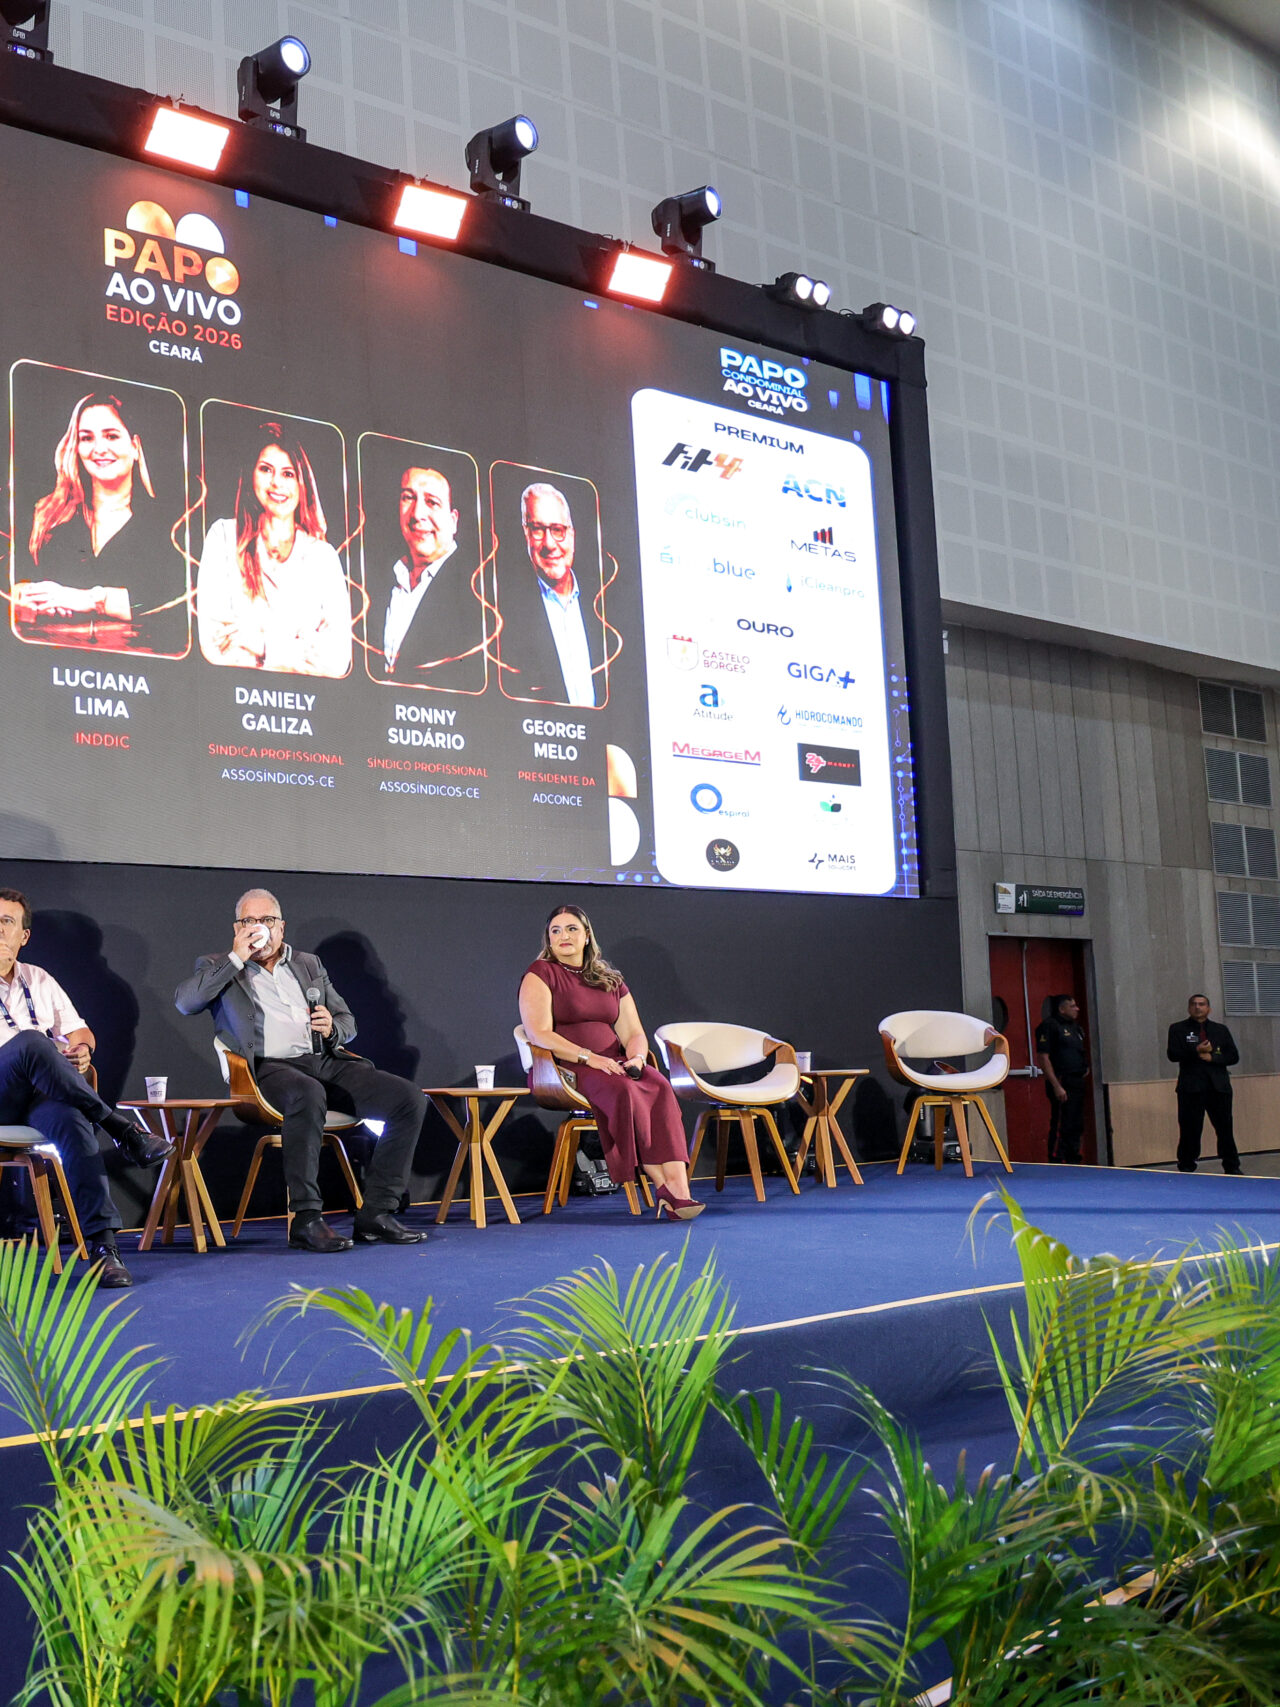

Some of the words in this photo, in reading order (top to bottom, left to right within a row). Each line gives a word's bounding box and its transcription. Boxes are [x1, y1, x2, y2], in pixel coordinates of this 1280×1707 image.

[104, 227, 240, 296] PAPO
[105, 271, 156, 306] AO
[162, 284, 242, 326] VIVO
[105, 303, 188, 337] EDIÇÃO
[193, 324, 243, 351] 2026
[148, 339, 203, 364] CEARÁ
[720, 347, 807, 389] PAPO
[721, 368, 806, 399] CONDOMINIAL
[722, 378, 754, 398] AO
[755, 386, 809, 413] VIVO
[714, 422, 804, 455] PREMIUM
[781, 472, 847, 508] ACN
[790, 539, 857, 563] METAS
[712, 557, 756, 580] blue
[736, 618, 795, 638] OURO
[702, 649, 751, 665] CASTELO
[703, 659, 747, 674] BORGES
[52, 666, 150, 695] LUCIANA
[74, 696, 130, 719] LIMA
[234, 686, 316, 712] DANIELY
[241, 712, 314, 736] GALIZA
[395, 703, 457, 726] RONNY
[692, 708, 734, 722] Atitude
[795, 709, 863, 729] HIDROCOMANDO
[74, 732, 131, 749] INDDIC
[387, 727, 465, 751] SUDÁRIO
[522, 718, 587, 740] GEORGE
[260, 748, 345, 766] PROFISSIONAL
[534, 742, 578, 762] MELO
[414, 761, 489, 778] PROFISSIONAL
[518, 770, 579, 786] PRESIDENTE
[581, 775, 596, 786] DA
[532, 792, 583, 807] ADCONCE
[828, 853, 856, 865] MAIS
